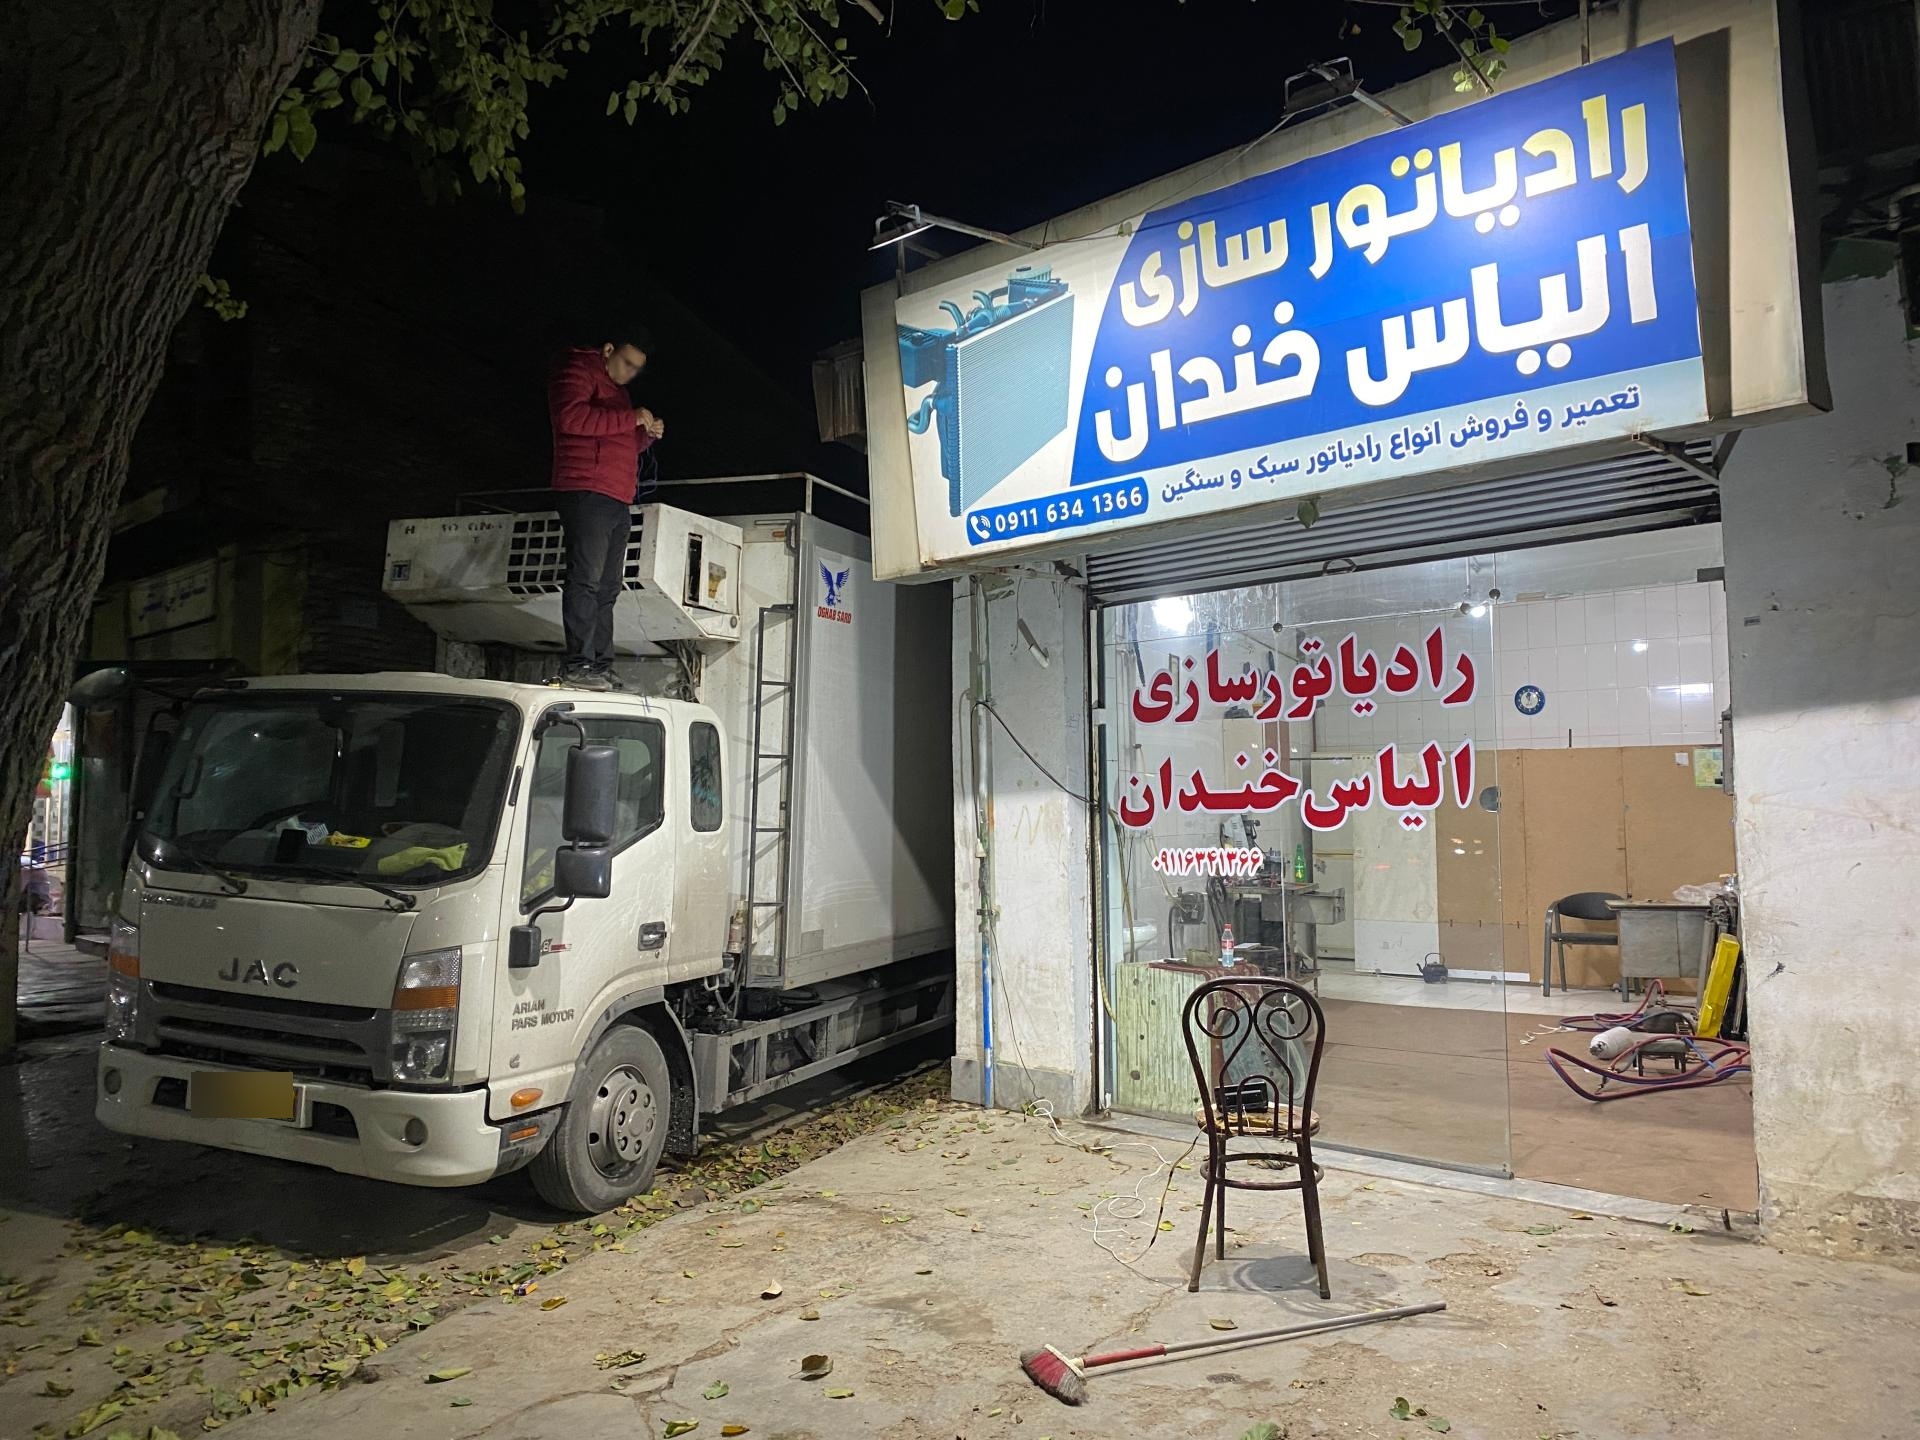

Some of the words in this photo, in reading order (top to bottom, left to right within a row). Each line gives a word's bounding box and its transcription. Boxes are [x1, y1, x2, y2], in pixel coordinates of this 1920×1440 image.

[1309, 94, 1649, 280] رادیاتور
[1118, 219, 1289, 328] سازی
[1346, 223, 1658, 407] الیاس
[1095, 301, 1321, 463] خندان
[1449, 399, 1529, 448] فروش
[1536, 407, 1552, 432] و
[1561, 385, 1641, 427] تعمیر
[1306, 434, 1382, 474] رادیاتور
[1389, 421, 1442, 460] انواع
[1161, 467, 1225, 503] سنگین
[1229, 468, 1242, 490] و
[1247, 455, 1300, 481] سبک
[995, 506, 1039, 533] 0911
[1046, 499, 1084, 522] 634
[1092, 486, 1143, 515] 1366
[1119, 749, 1300, 828] خندان
[1303, 742, 1474, 830] الیاس
[218, 957, 300, 989] JAC
[511, 1015, 538, 1031] PARS
[541, 1008, 575, 1026] MOTOR
[512, 999, 546, 1016] ARIAN
